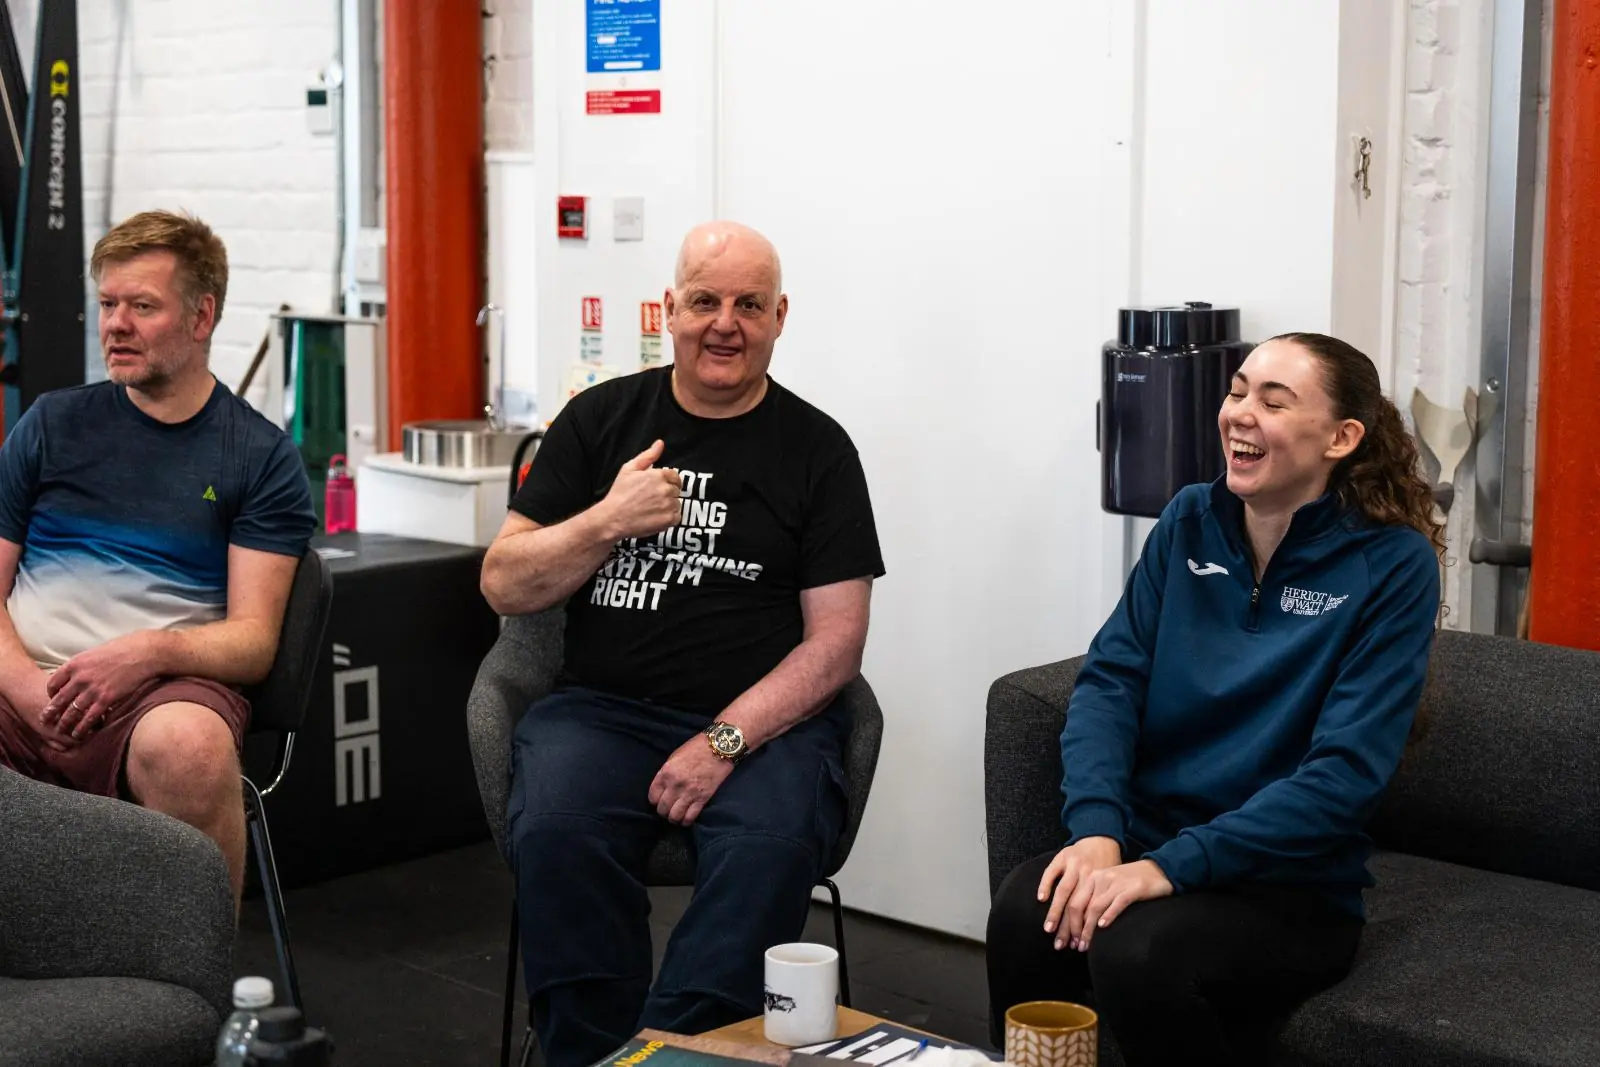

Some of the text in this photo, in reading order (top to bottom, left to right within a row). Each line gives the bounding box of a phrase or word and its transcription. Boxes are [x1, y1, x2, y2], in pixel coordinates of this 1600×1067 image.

[47, 213, 65, 231] 2
[648, 525, 721, 554] JUST
[662, 560, 704, 586] I'M
[590, 577, 668, 611] RIGHT
[1282, 586, 1328, 602] HERIOT
[1295, 599, 1324, 611] WATT
